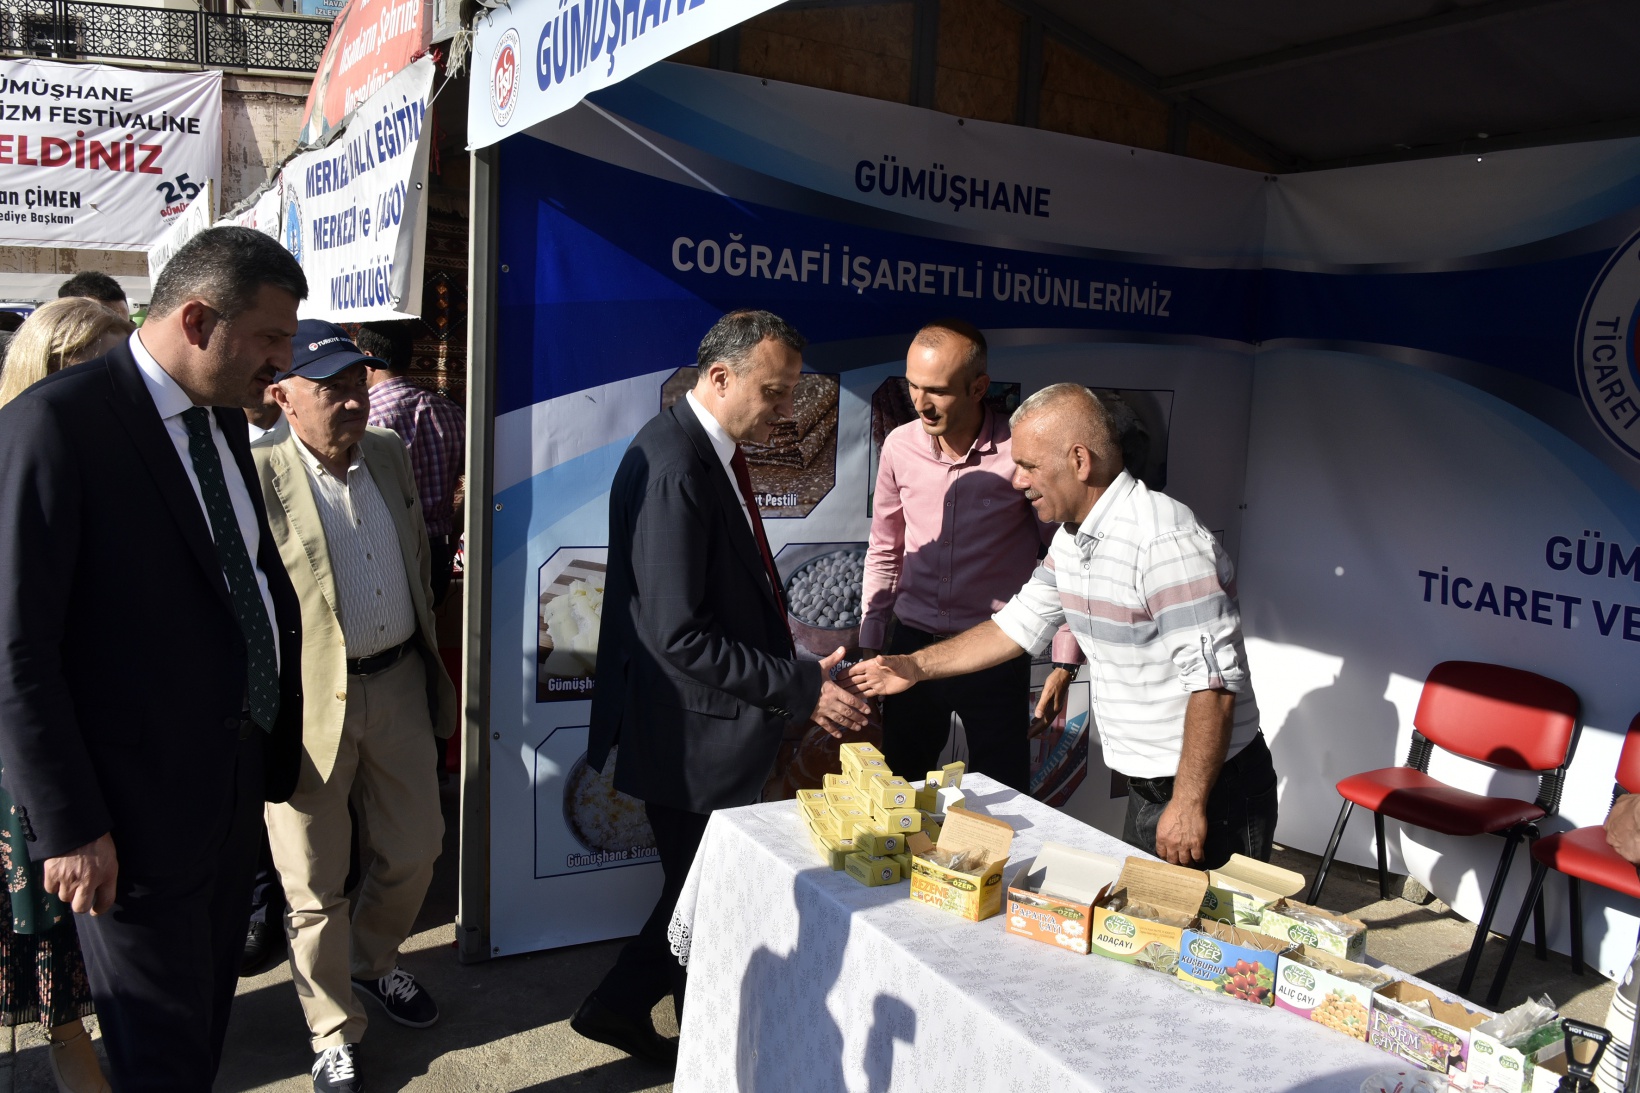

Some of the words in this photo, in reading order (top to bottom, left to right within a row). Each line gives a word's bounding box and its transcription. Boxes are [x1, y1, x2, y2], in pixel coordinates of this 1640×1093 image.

[536, 0, 706, 91] GÜMÜŞHA
[49, 105, 200, 134] FESTİVALİNE
[0, 130, 163, 174] ELDİNİZ
[854, 154, 1051, 218] GÜMÜŞHANE
[25, 185, 81, 209] ÇİMEN
[30, 212, 74, 226] Başkanı
[312, 196, 357, 252] MERKEZİ
[359, 207, 371, 238] ve
[671, 233, 831, 285] COĞRAFİ
[840, 251, 983, 299] İŞARETLİ
[992, 263, 1172, 318] ÜRÜNLERİMİZ
[765, 493, 797, 507] Pestili
[1545, 529, 1640, 582] GÜM
[1417, 565, 1582, 630] TİCARET
[1591, 599, 1640, 643] VE
[548, 676, 596, 693] Gümüşh
[1057, 721, 1081, 758] KİLİMİ
[566, 850, 628, 868] Gümüşhane
[912, 876, 950, 899] REZENE
[1011, 903, 1056, 925] PAPATYA
[1039, 921, 1062, 934] ÇAYI
[1105, 919, 1135, 936] ÖZER
[1289, 928, 1318, 947] ÖZER
[1096, 933, 1133, 950] ADAÇAYI
[1190, 943, 1221, 961] ÖZER
[1181, 955, 1227, 976] KUŞBURNU
[1191, 966, 1211, 979] ÇAYI
[1284, 969, 1314, 989] ÖZER
[1278, 985, 1297, 1000] ALIÇ
[1297, 991, 1316, 1006] ÇAYI
[1372, 1008, 1419, 1050] FORM
[1568, 1026, 1583, 1035] HOT
[1582, 1030, 1604, 1042] WATER
[1371, 1032, 1401, 1054] ÇAYI
